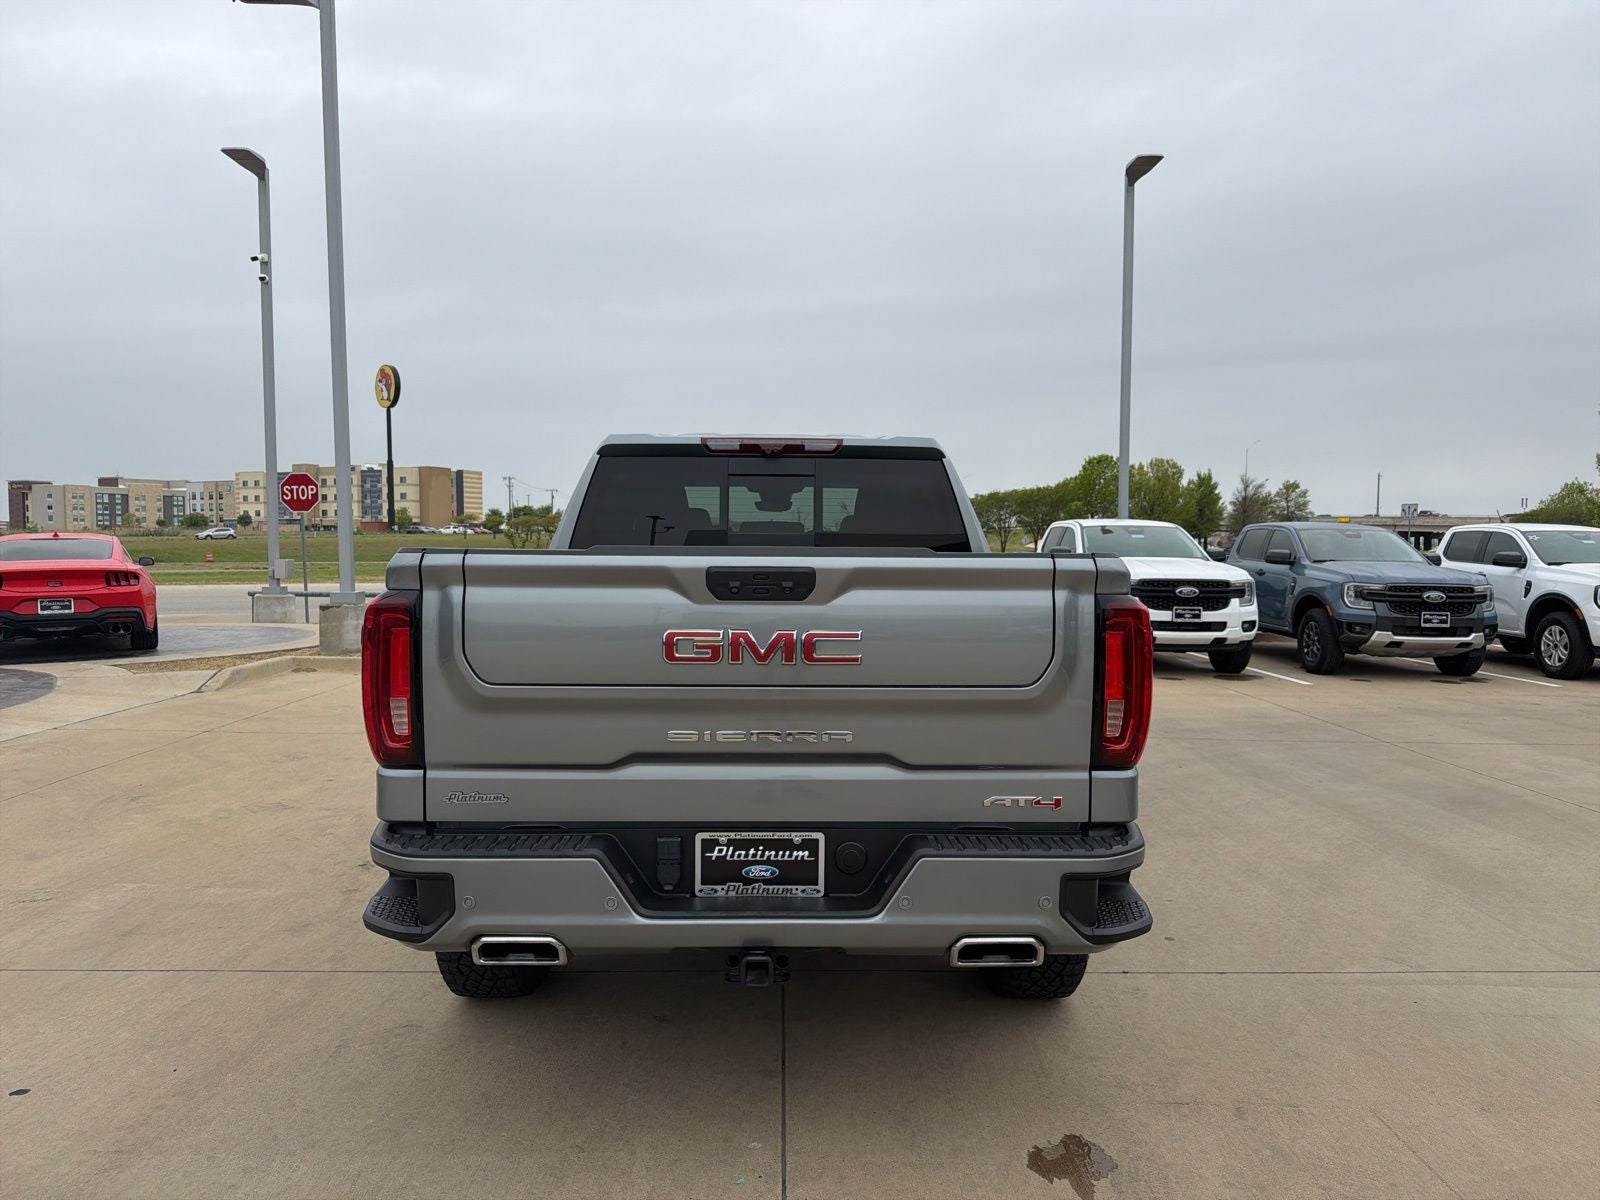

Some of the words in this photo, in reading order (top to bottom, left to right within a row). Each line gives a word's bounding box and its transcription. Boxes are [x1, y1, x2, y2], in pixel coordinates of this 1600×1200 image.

[283, 485, 317, 500] STOP
[663, 629, 862, 665] GMC
[666, 730, 853, 743] SIERRA
[983, 796, 1063, 811] AT4
[705, 846, 815, 860] Platinum
[725, 883, 799, 896] Platinum
